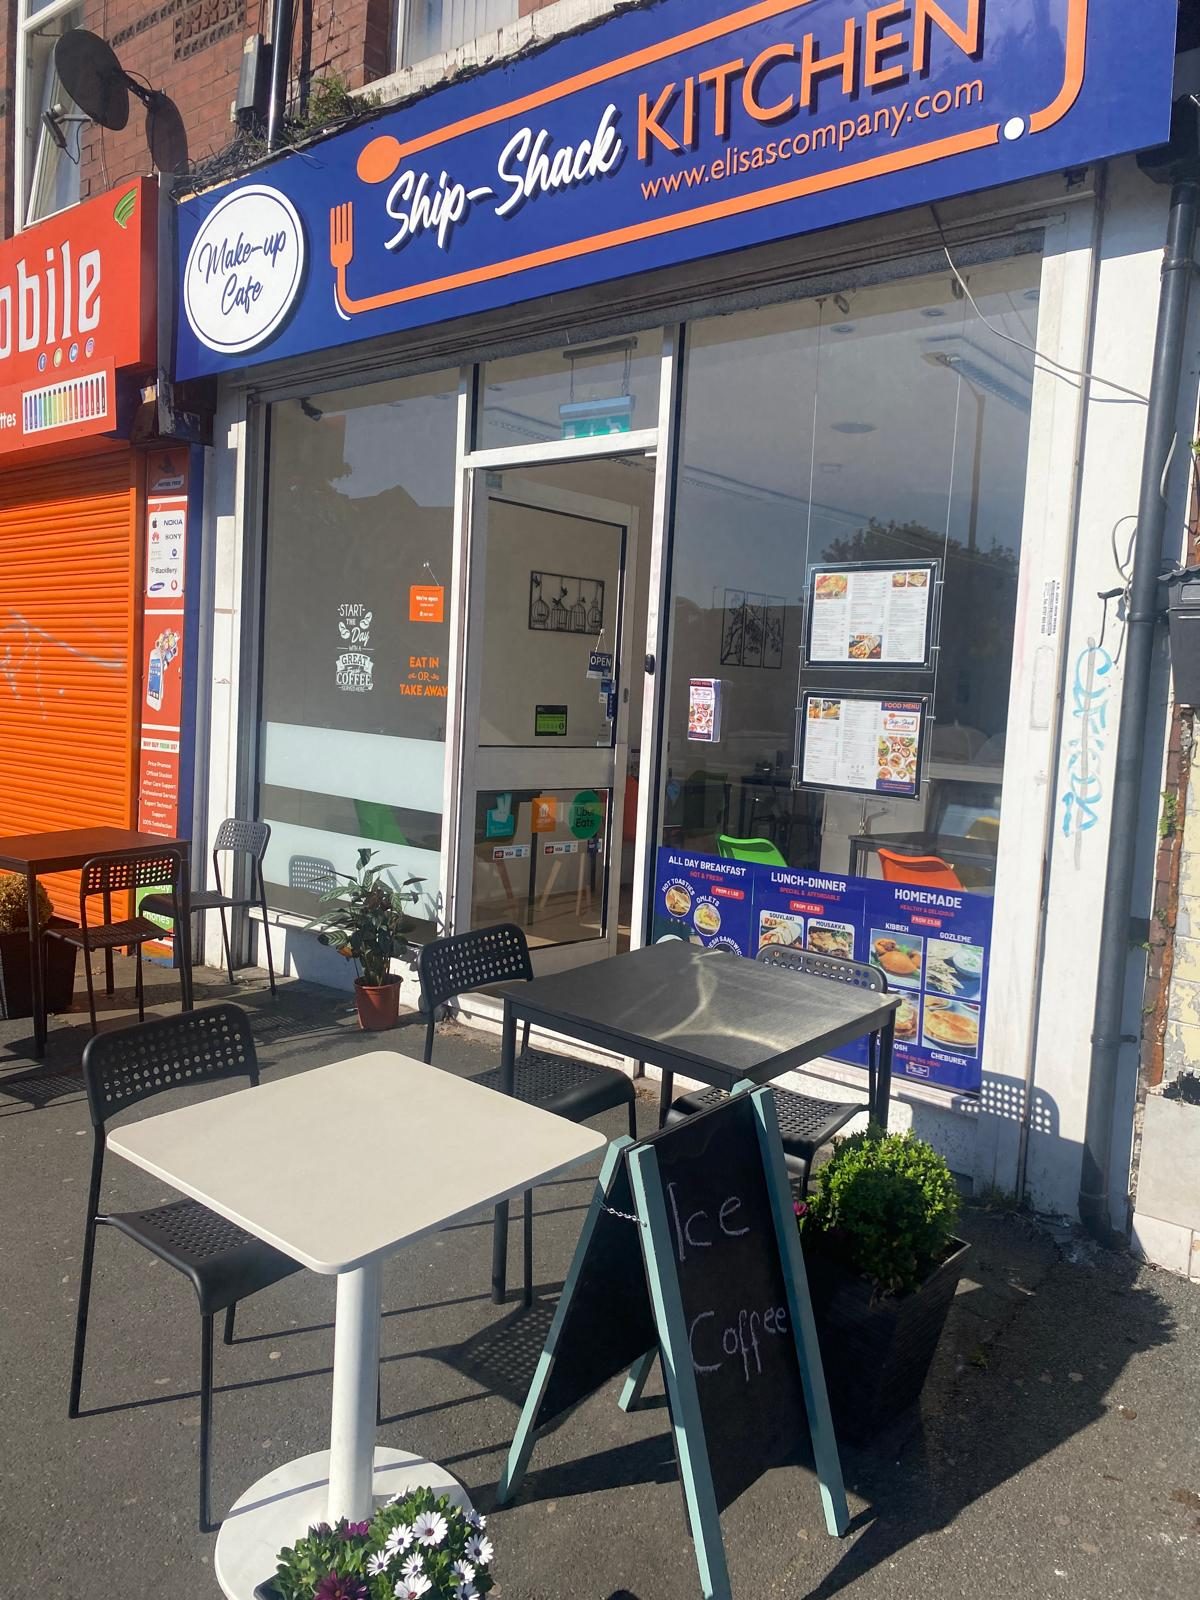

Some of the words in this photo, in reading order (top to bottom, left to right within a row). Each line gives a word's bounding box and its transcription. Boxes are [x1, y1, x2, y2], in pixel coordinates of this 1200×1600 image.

[637, 0, 980, 161] KITCHEN
[640, 78, 984, 200] www.elisascompany.com
[198, 230, 287, 284] Make-up
[221, 272, 264, 316] Cafe
[340, 604, 363, 617] START
[346, 618, 356, 626] THE
[351, 626, 370, 647] Day
[341, 654, 368, 666] GREAT
[409, 656, 429, 668] EAT
[430, 657, 439, 669] IN
[590, 655, 612, 667] OPEN
[336, 671, 371, 686] COFFEE
[417, 671, 430, 681] OR
[400, 684, 423, 696] TAKE
[424, 685, 449, 698] AWAY
[576, 818, 595, 828] Eats
[668, 855, 684, 866] ALL
[684, 858, 699, 869] DAY
[700, 861, 747, 877] BREAKFAST
[661, 879, 672, 893] HOT
[671, 877, 696, 896] TOASTIES
[770, 871, 847, 893] LUNCH-DINNER
[696, 895, 720, 907] OMLETS
[894, 888, 962, 909] HOMEMADE
[815, 920, 846, 931] MOUSAKKA
[885, 922, 909, 933] KIBBEH
[939, 931, 972, 944] GOZLEME
[930, 1051, 968, 1066] CHEBUREK
[668, 1182, 750, 1262] Ice
[688, 1304, 787, 1382] Coffee
